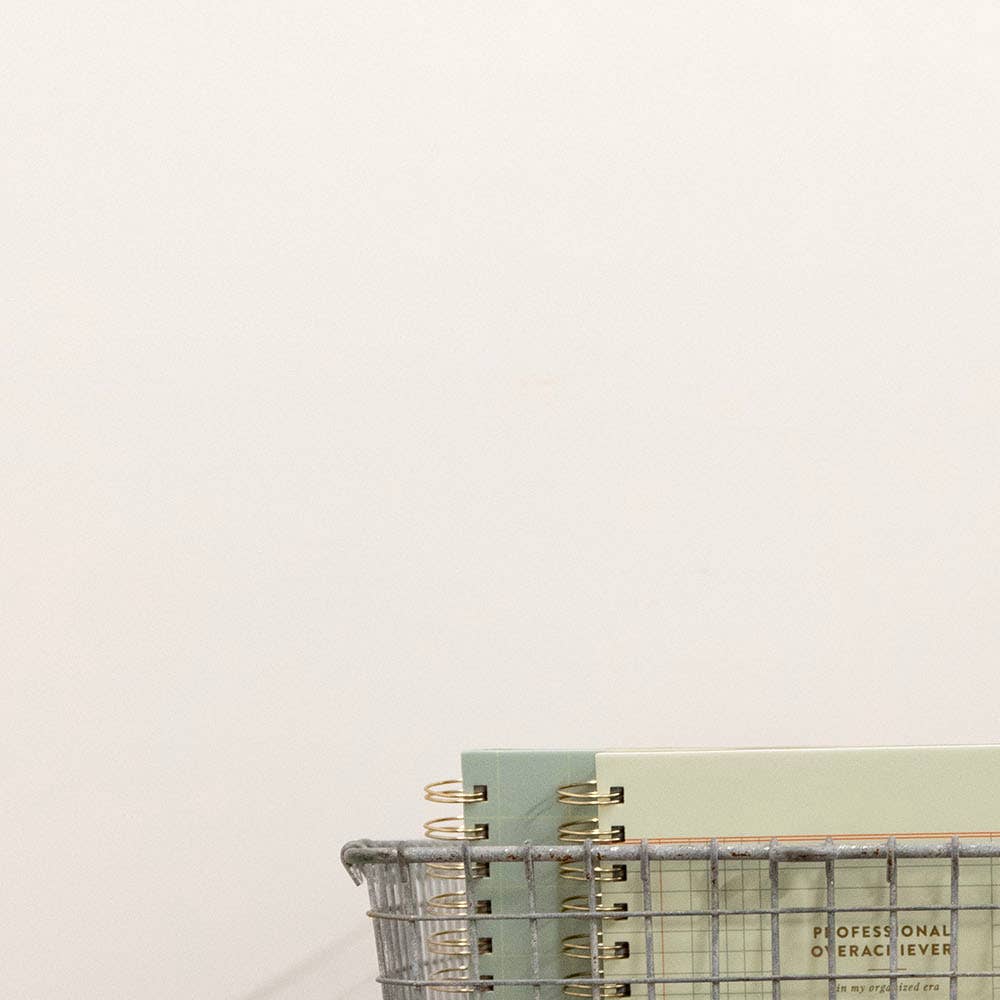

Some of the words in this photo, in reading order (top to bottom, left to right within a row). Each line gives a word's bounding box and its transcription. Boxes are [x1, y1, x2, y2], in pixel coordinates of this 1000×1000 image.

[836, 983, 847, 993] in
[850, 985, 865, 994] my
[869, 982, 920, 994] orgaized
[923, 984, 940, 992] era
